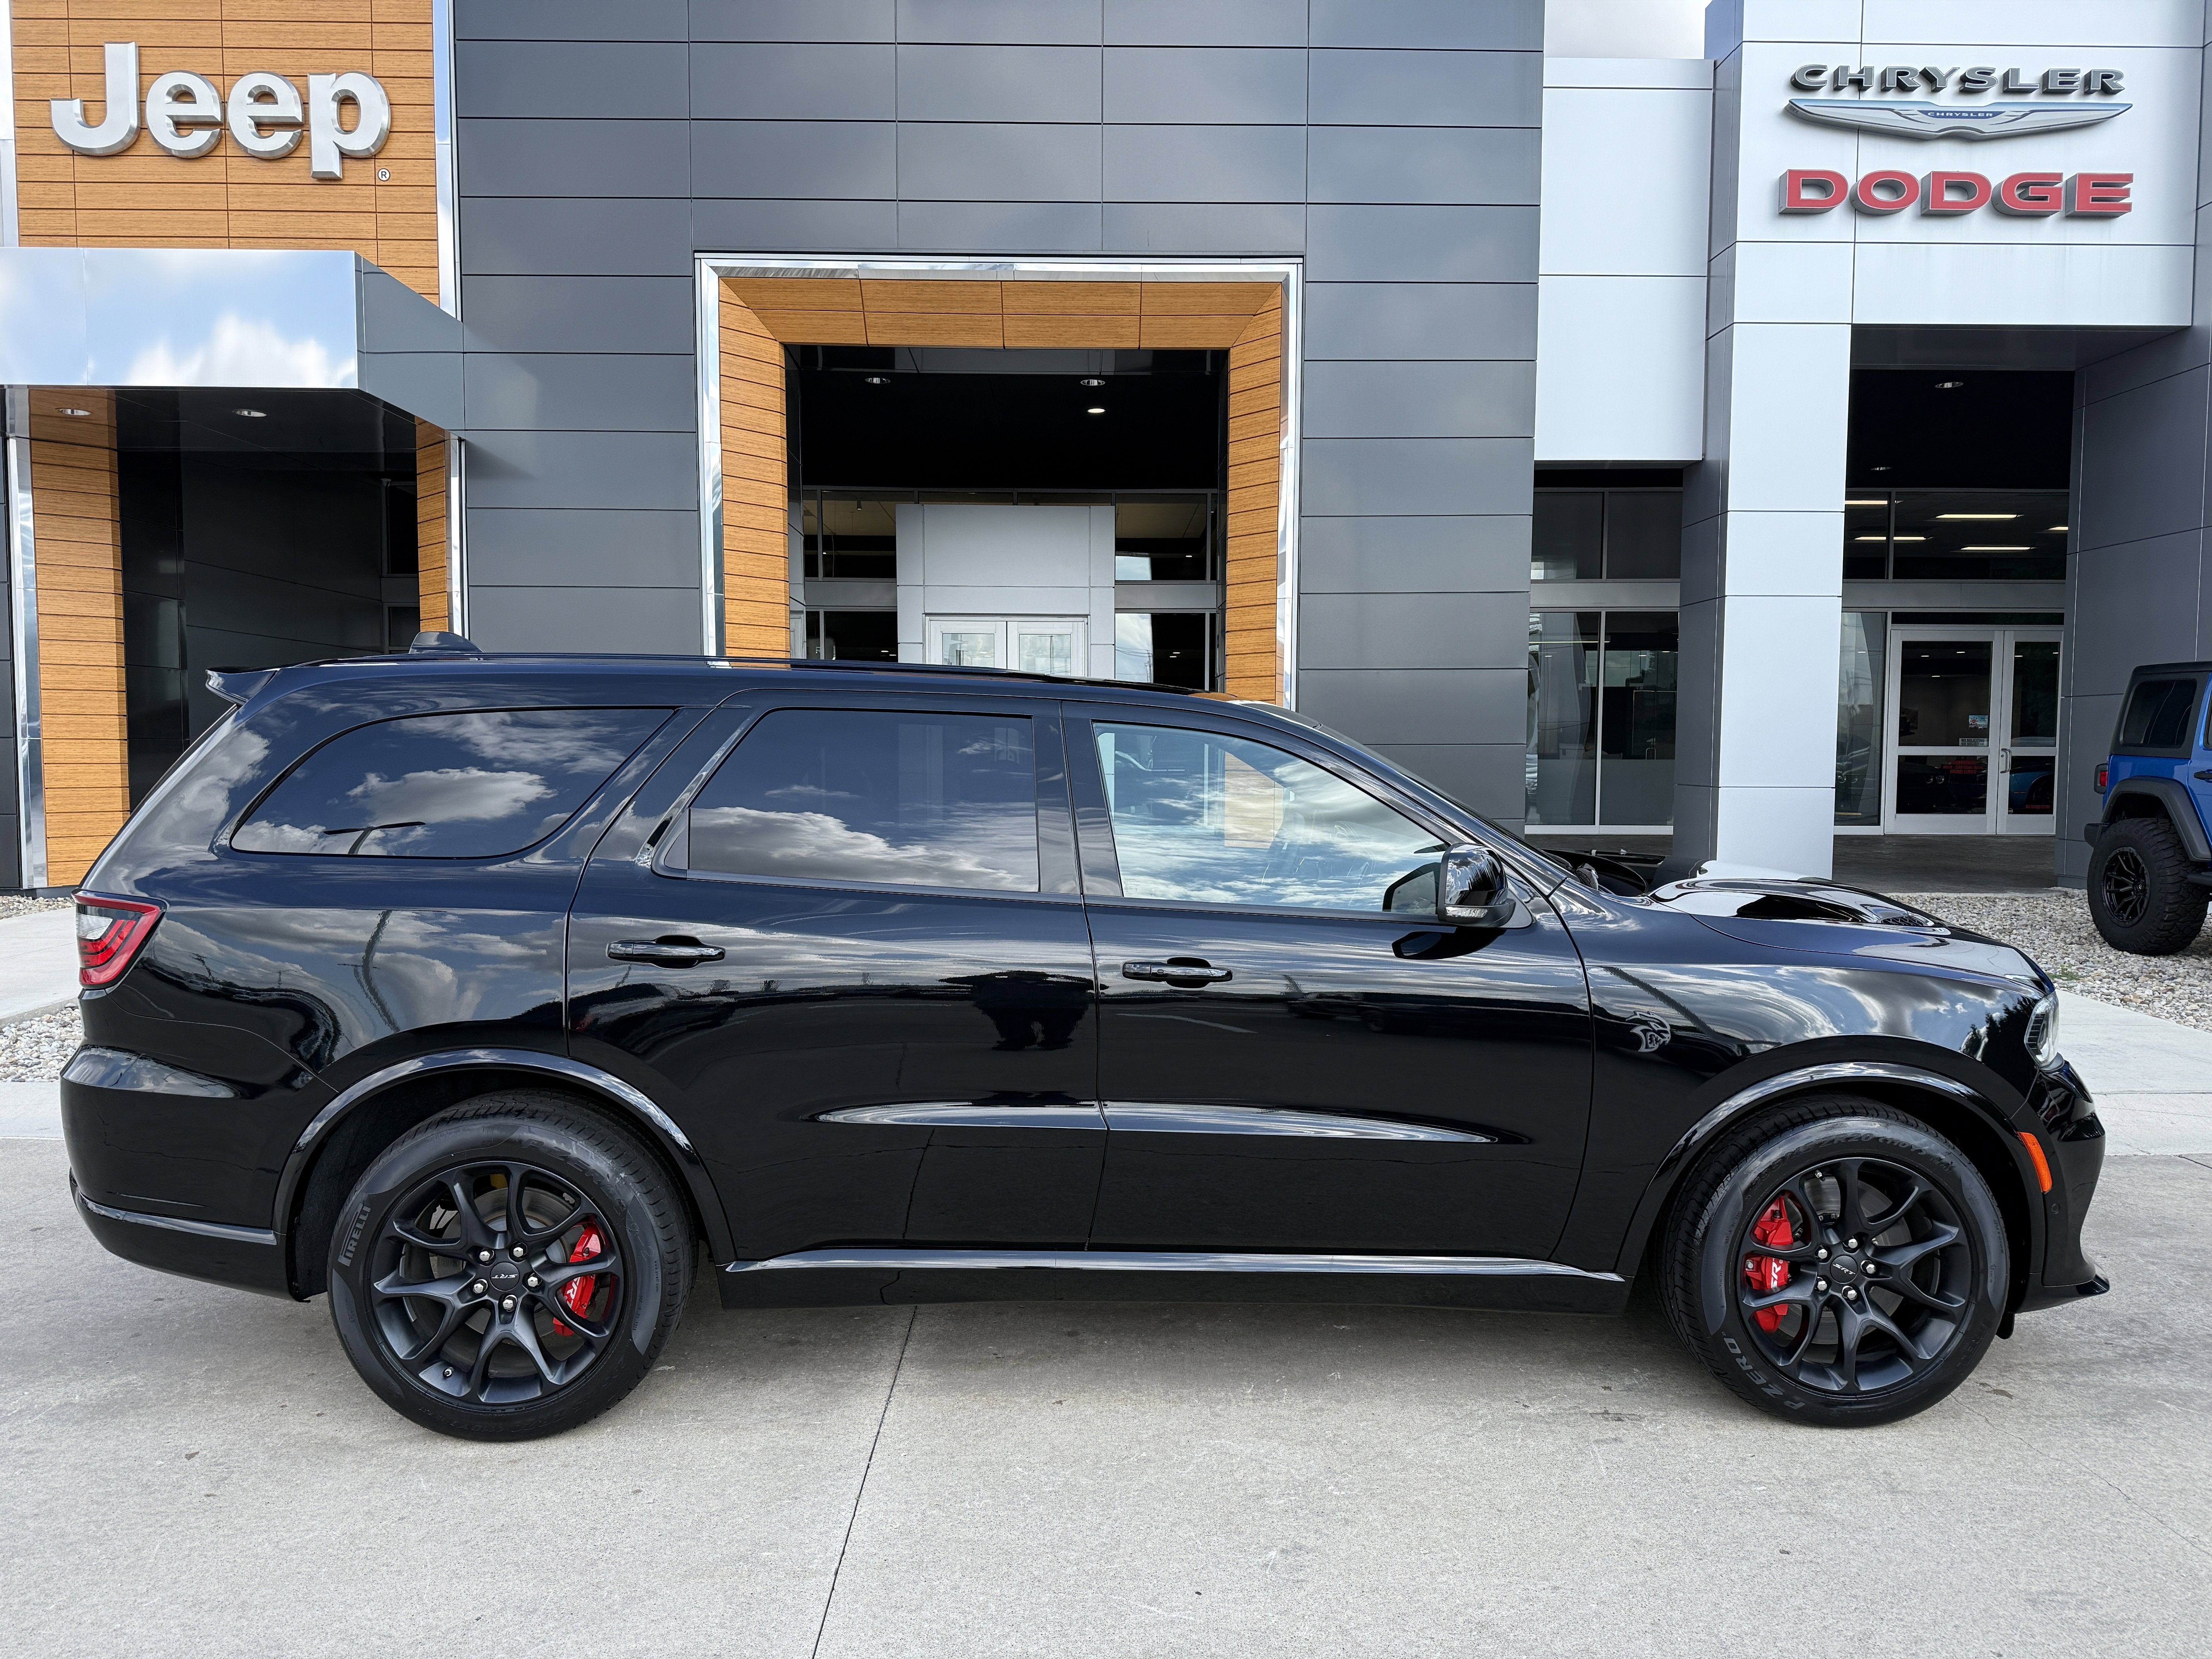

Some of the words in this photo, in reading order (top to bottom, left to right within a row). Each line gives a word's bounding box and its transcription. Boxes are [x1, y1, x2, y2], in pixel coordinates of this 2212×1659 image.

[1791, 64, 2125, 94] CHRYSLER
[50, 41, 391, 180] Jeep
[1779, 169, 2134, 217] DODGE
[338, 1202, 371, 1266] PIRELLI
[1771, 1257, 1781, 1289] SR
[1832, 1263, 1856, 1275] SRT
[1723, 1337, 1784, 1398] ZERO
